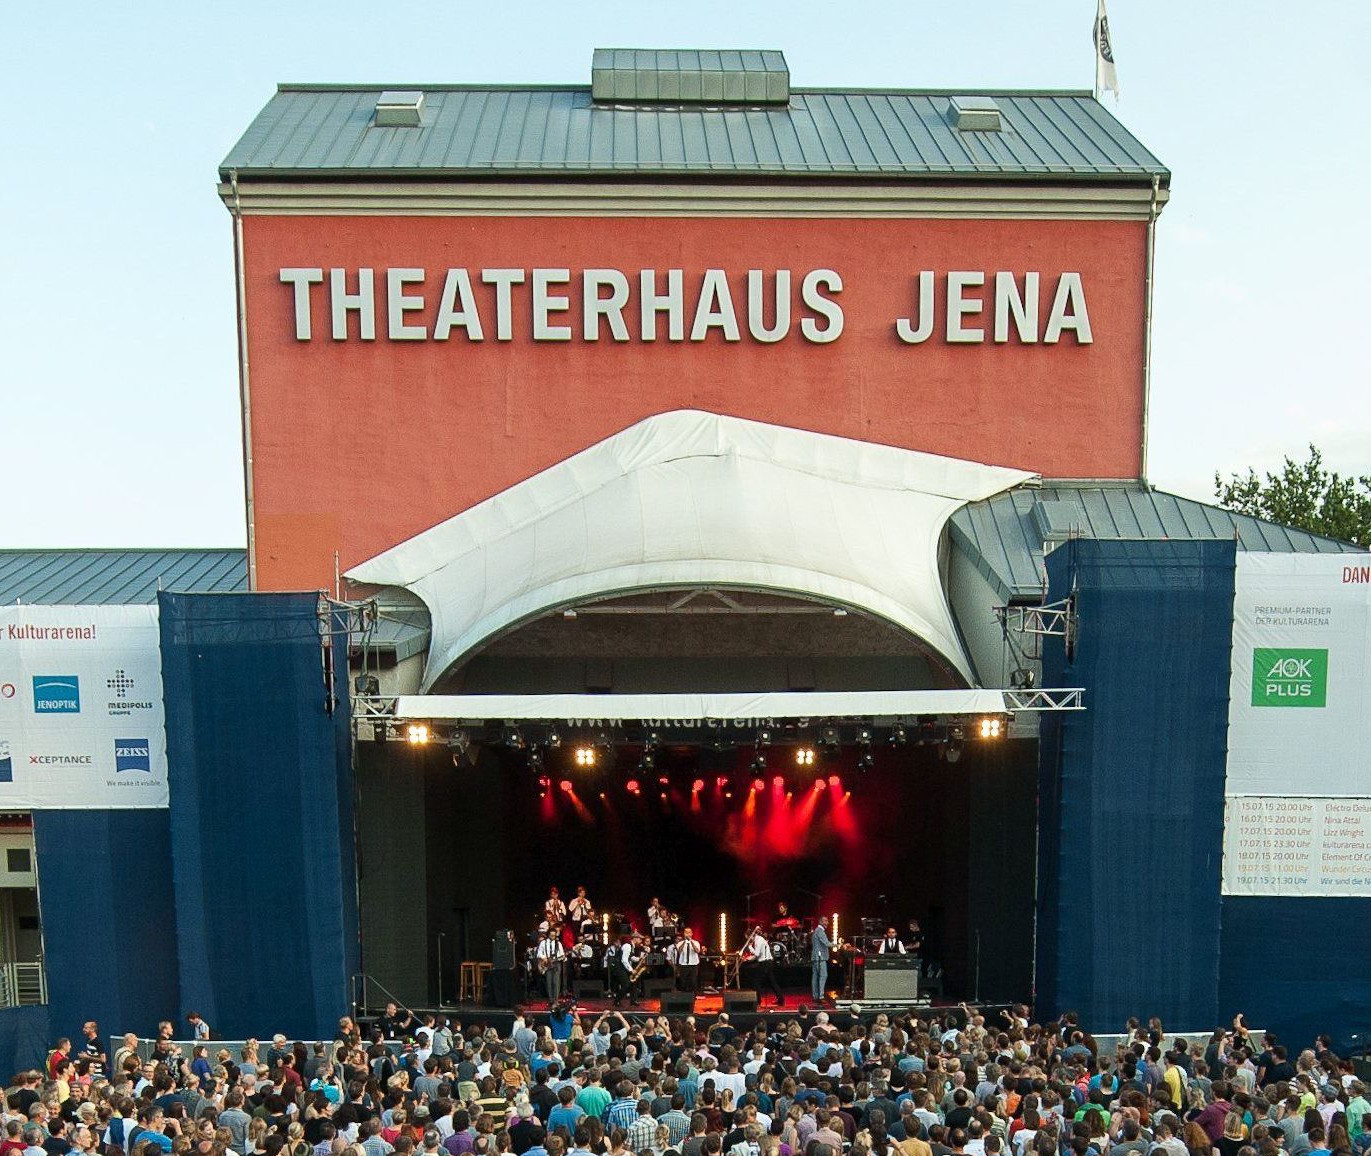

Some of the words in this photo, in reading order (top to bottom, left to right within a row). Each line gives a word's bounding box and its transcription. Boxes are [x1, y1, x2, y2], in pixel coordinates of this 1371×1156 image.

[278, 267, 845, 343] THEATERHAUS
[895, 269, 1093, 345] JENA
[1254, 606, 1332, 615] PREMIUM-PARTNER
[1255, 617, 1272, 625] DER
[1272, 617, 1330, 626] KULTURARENA
[8, 623, 97, 640] Kulturarena!
[1266, 658, 1313, 678] AOK
[1266, 684, 1312, 697] PLUS
[36, 700, 78, 710] JENOPTIK
[115, 747, 149, 757] ZEISS
[29, 755, 92, 764] XCEPTANCE
[1299, 803, 1313, 811] Uhr
[1325, 804, 1352, 813] Electro
[1298, 815, 1312, 823] Uhr
[1324, 816, 1342, 824] Nina
[1297, 828, 1312, 836] Uhr
[1323, 829, 1339, 837] Lizz
[1339, 829, 1364, 838] Wright
[1296, 840, 1311, 848] Uhr
[1322, 841, 1366, 849] kulturarena
[1295, 852, 1310, 860] Uhr
[1321, 853, 1352, 861] Element
[1353, 853, 1363, 861] Of
[1321, 865, 1350, 874] Wunder
[1294, 876, 1308, 885] Uhr
[1320, 877, 1335, 886] Wir
[1335, 877, 1351, 886] sind
[1351, 878, 1363, 886] die
